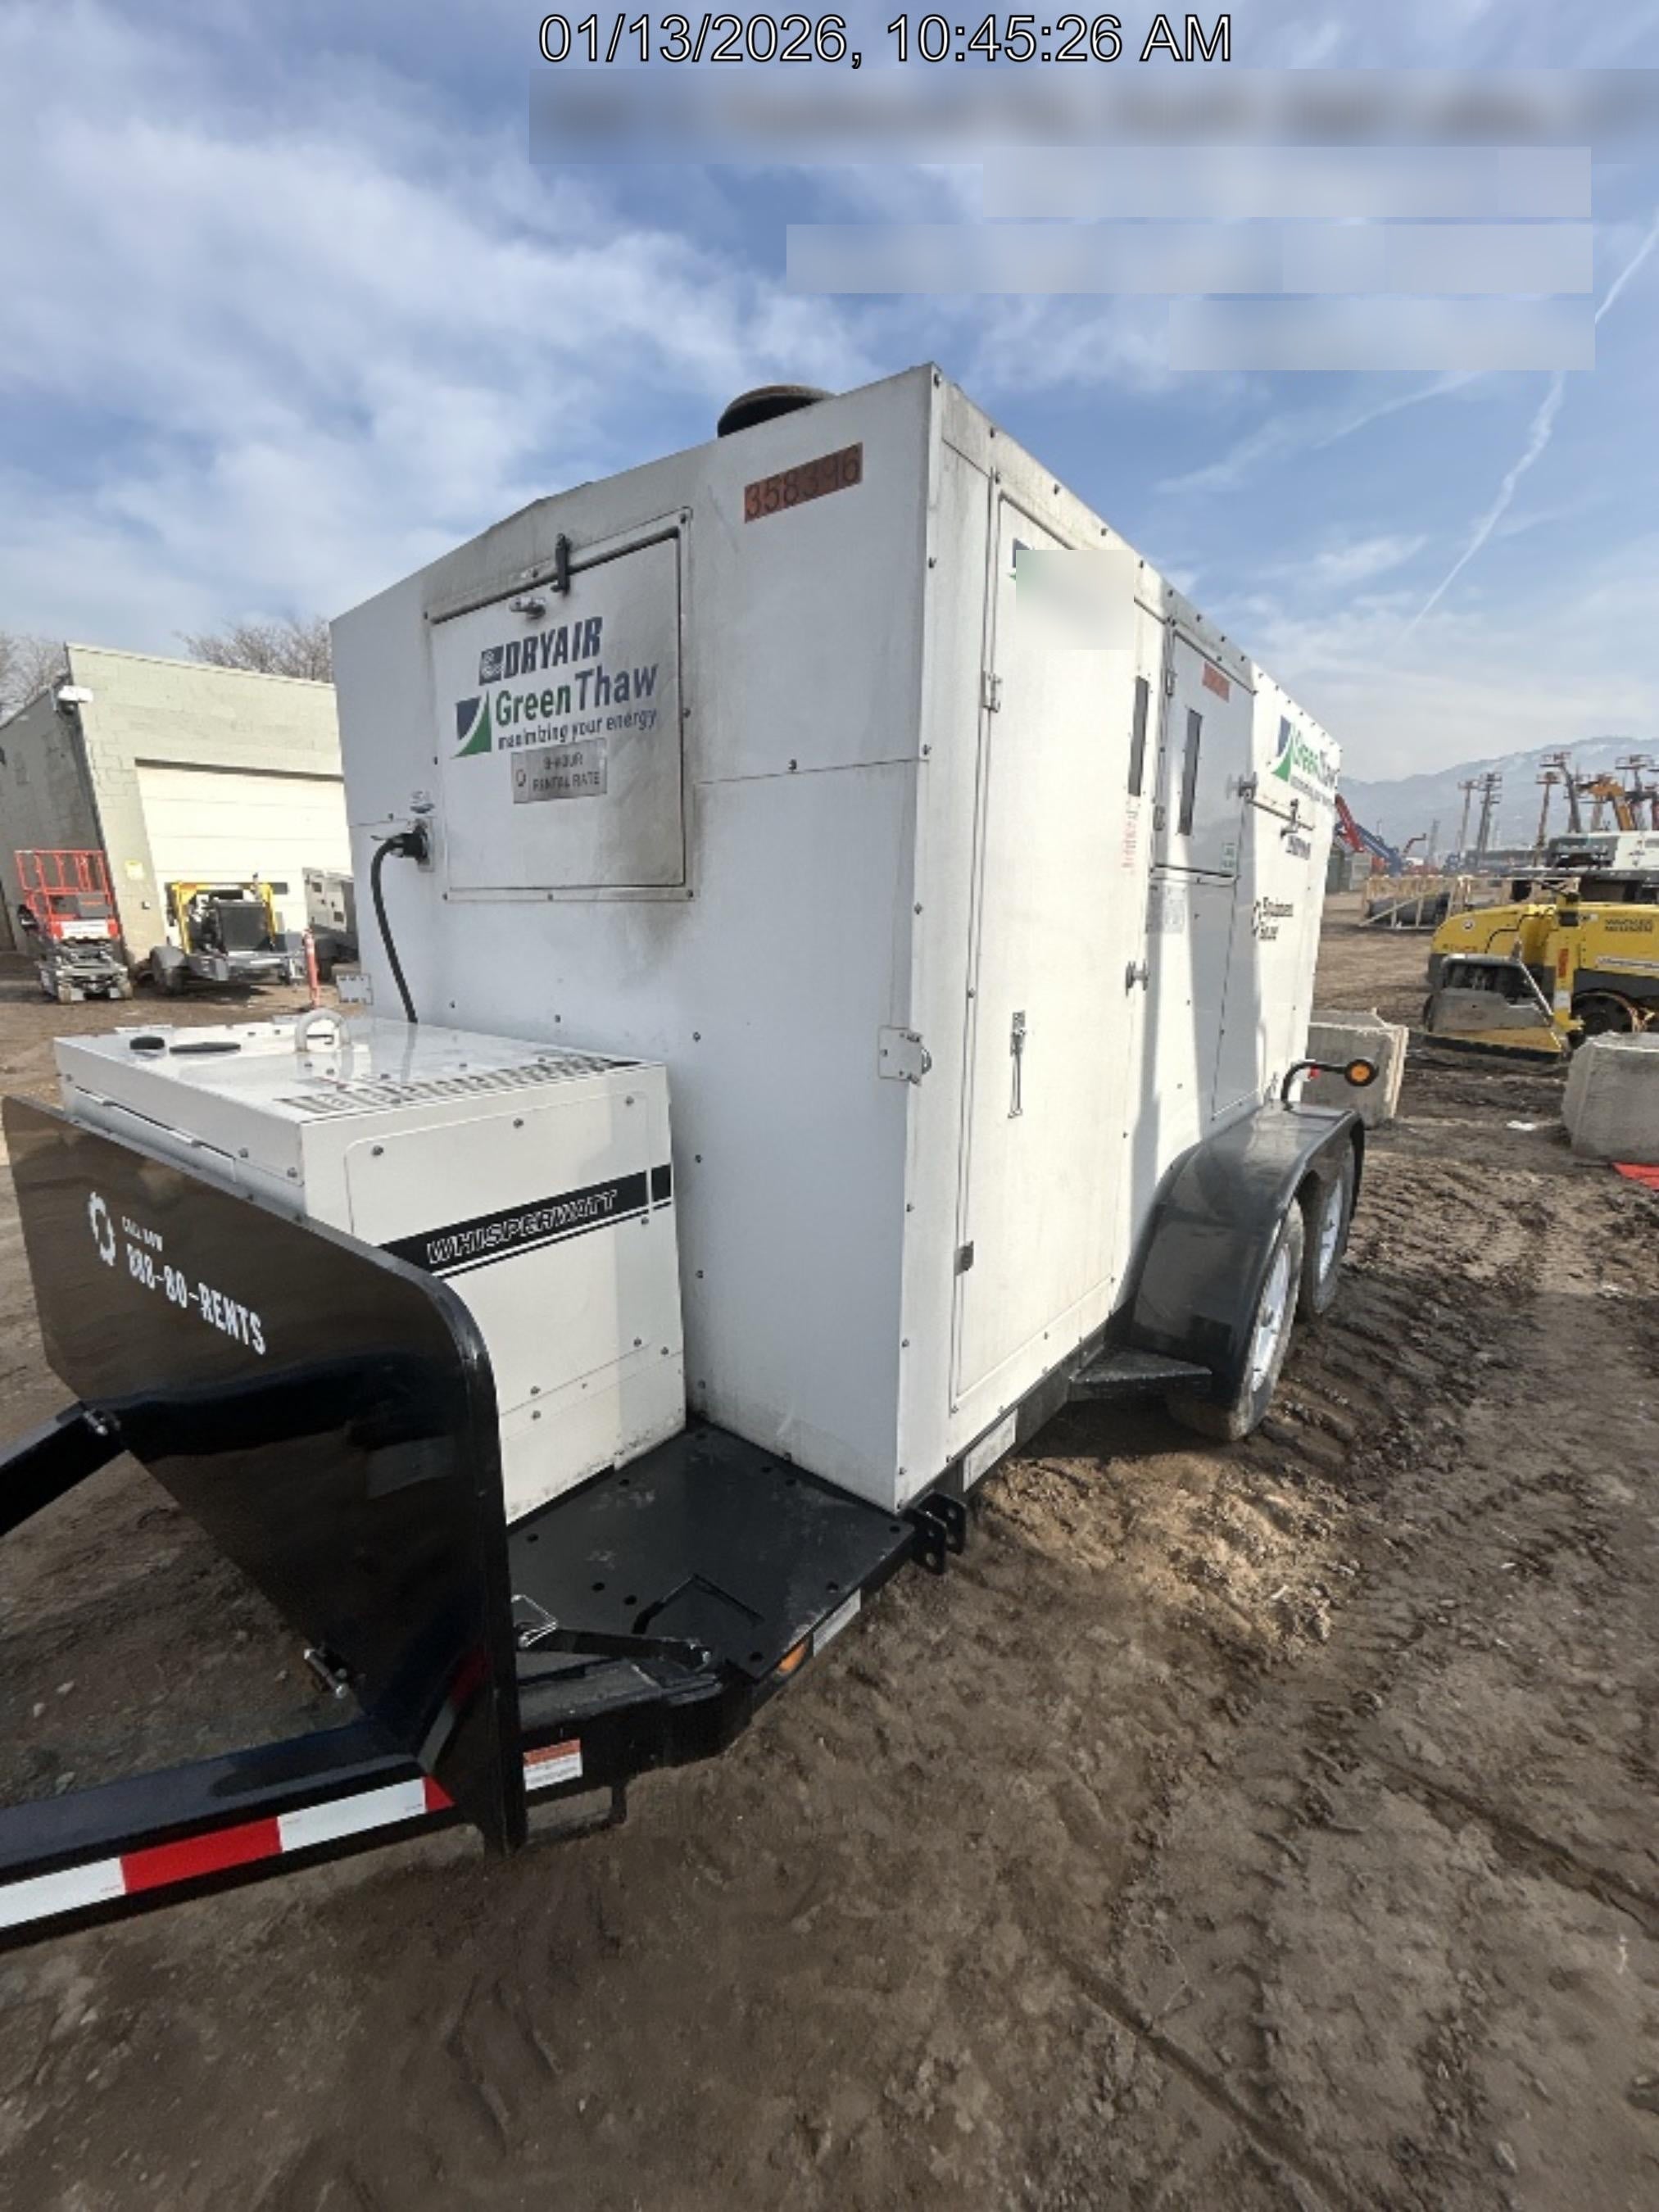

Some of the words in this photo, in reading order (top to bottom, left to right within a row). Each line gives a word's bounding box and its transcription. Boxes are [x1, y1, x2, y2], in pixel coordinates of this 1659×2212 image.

[504, 617, 602, 679] DRYAIR
[605, 709, 658, 732] energy
[427, 1190, 619, 1264] WHISPERWATT
